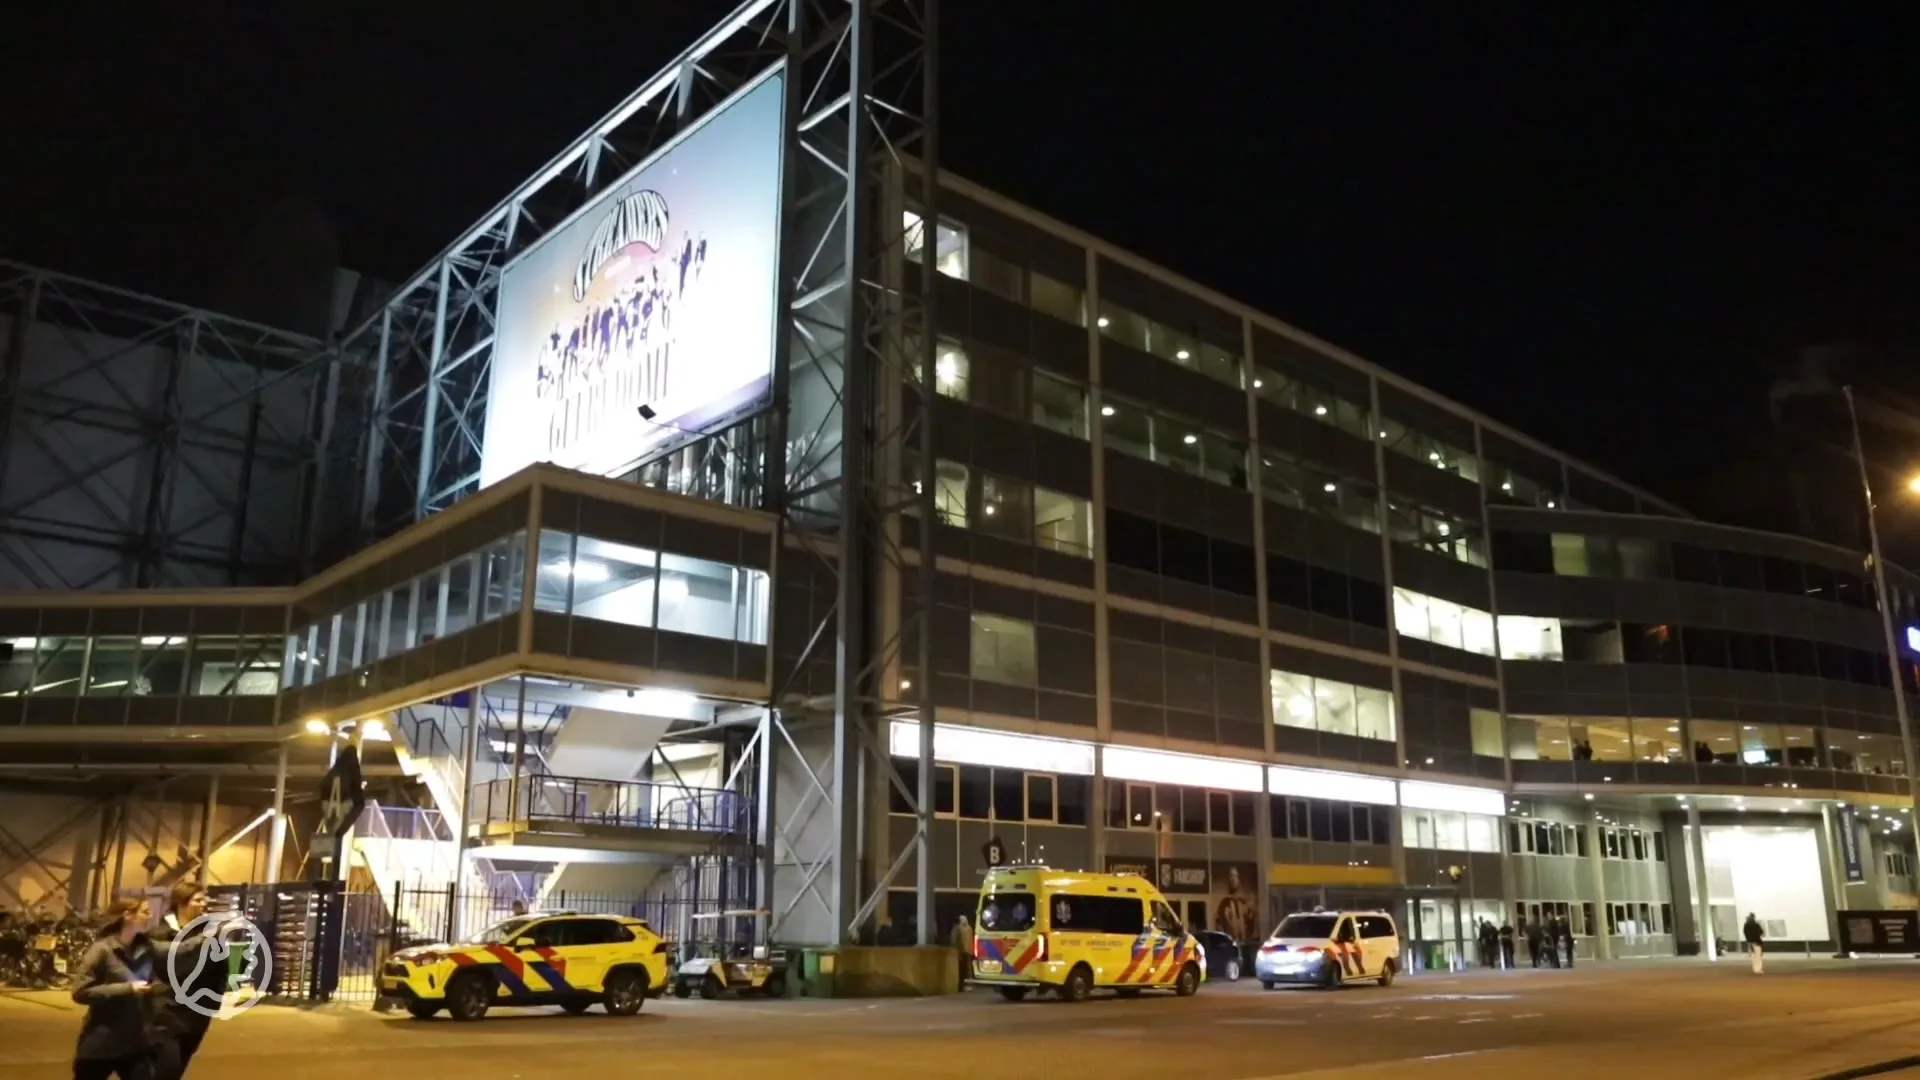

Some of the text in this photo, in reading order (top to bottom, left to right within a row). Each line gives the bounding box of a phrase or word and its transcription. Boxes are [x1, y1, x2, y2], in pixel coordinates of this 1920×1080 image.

[328, 776, 340, 817] A
[990, 846, 1000, 864] B
[1174, 868, 1205, 885] FANSHOP
